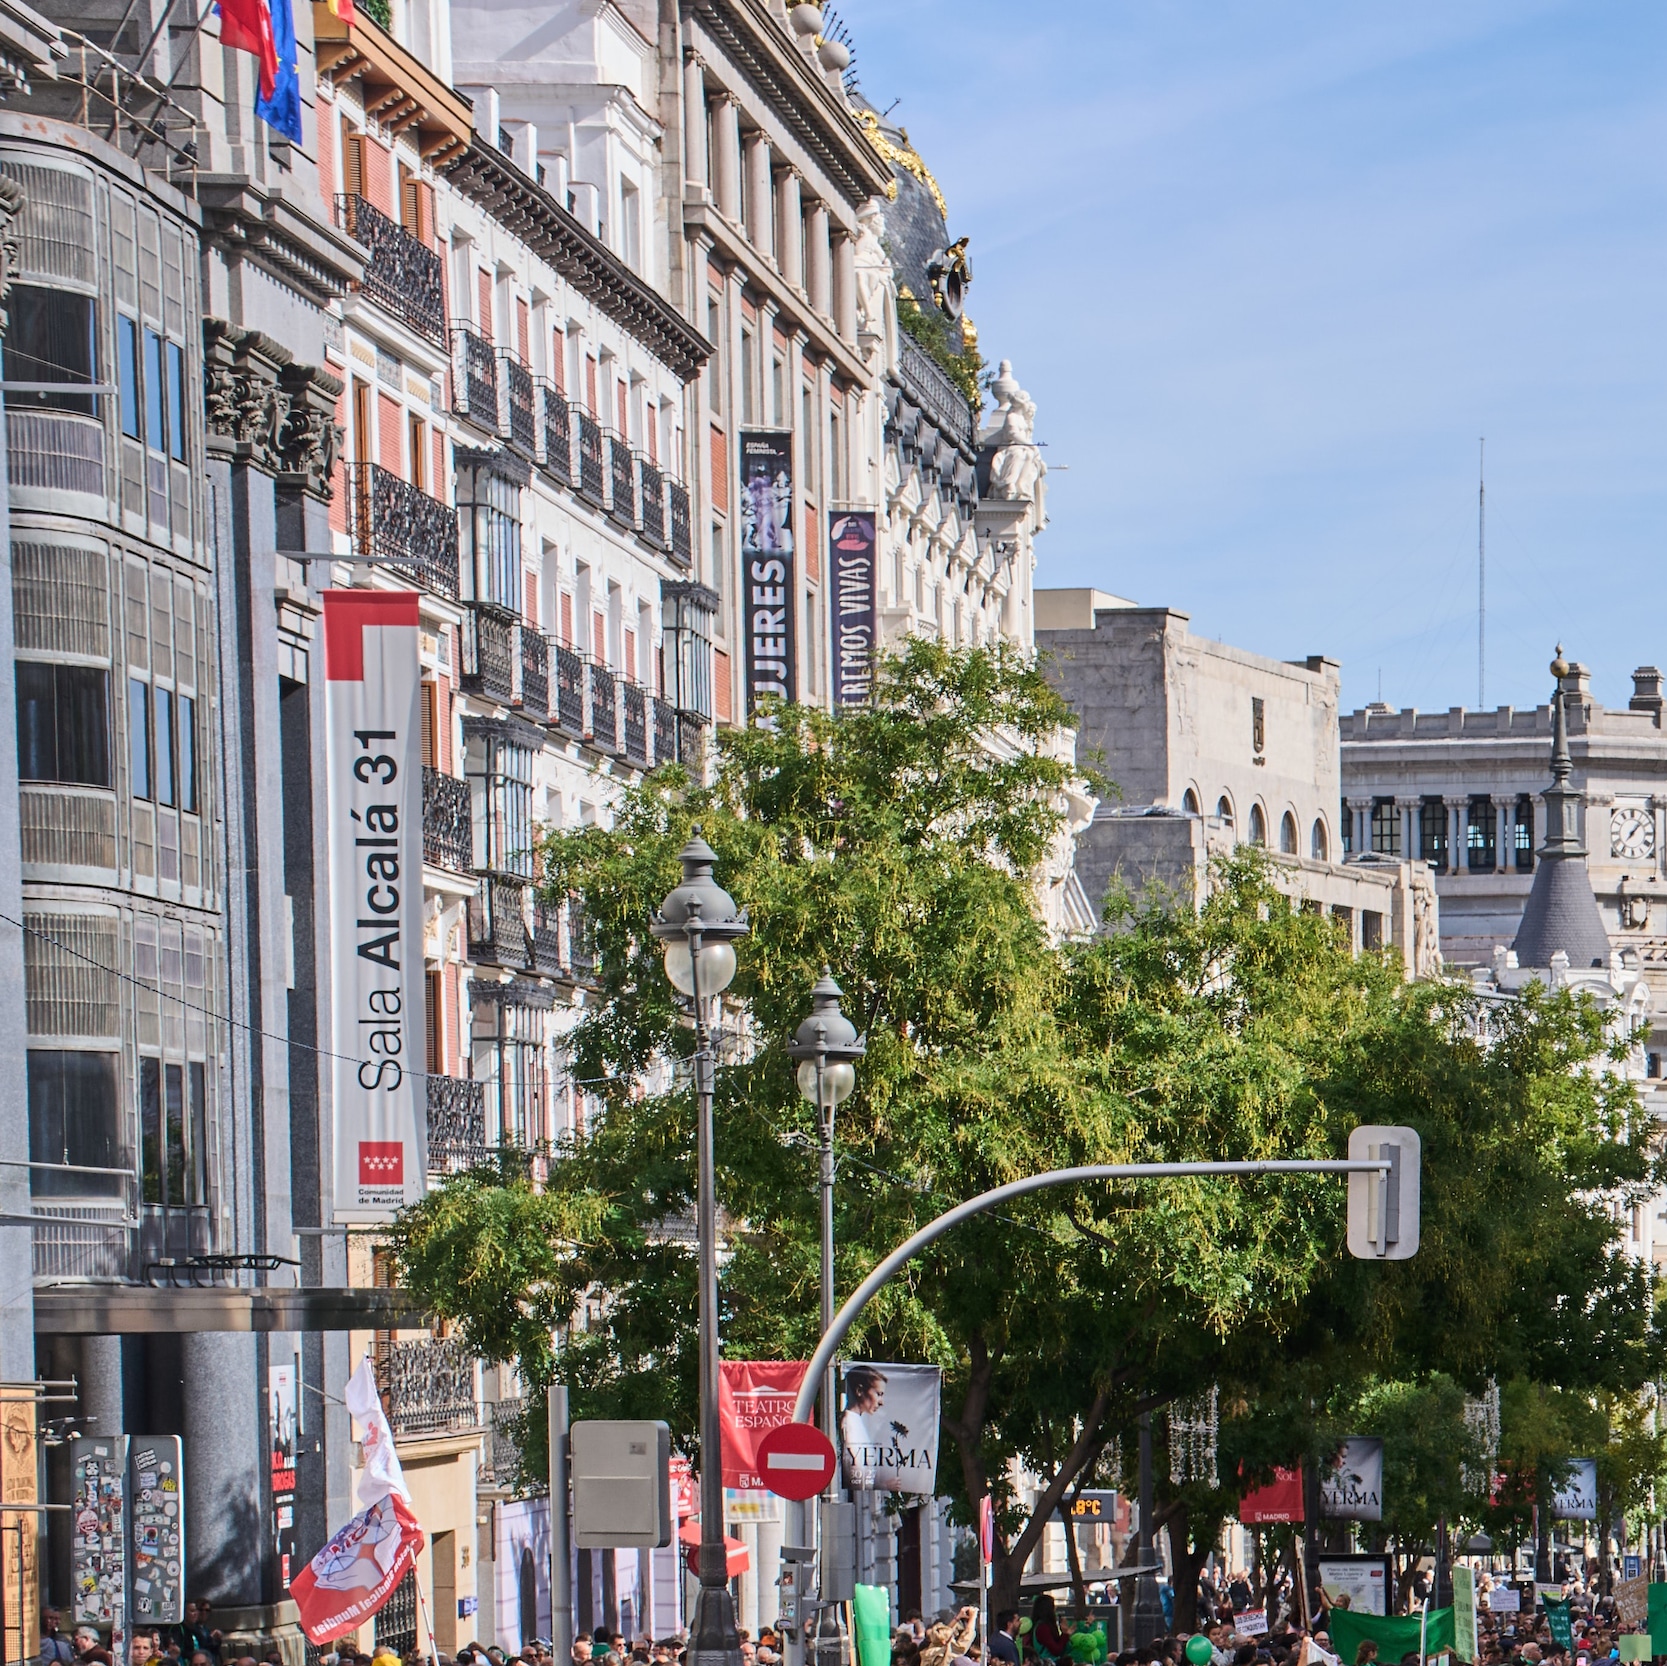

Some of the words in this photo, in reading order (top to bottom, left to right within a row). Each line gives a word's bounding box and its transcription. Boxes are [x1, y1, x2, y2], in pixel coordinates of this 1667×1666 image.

[839, 557, 871, 617] VIVAS
[752, 560, 788, 732] UJERES
[354, 731, 398, 785] 31
[351, 805, 401, 972] Alcalá
[358, 987, 402, 1091] Sala
[359, 1188, 404, 1196] Comunidad
[847, 1448, 932, 1469] YERMA
[1262, 1512, 1290, 1520] MADRID
[1322, 1489, 1379, 1506] YERMA
